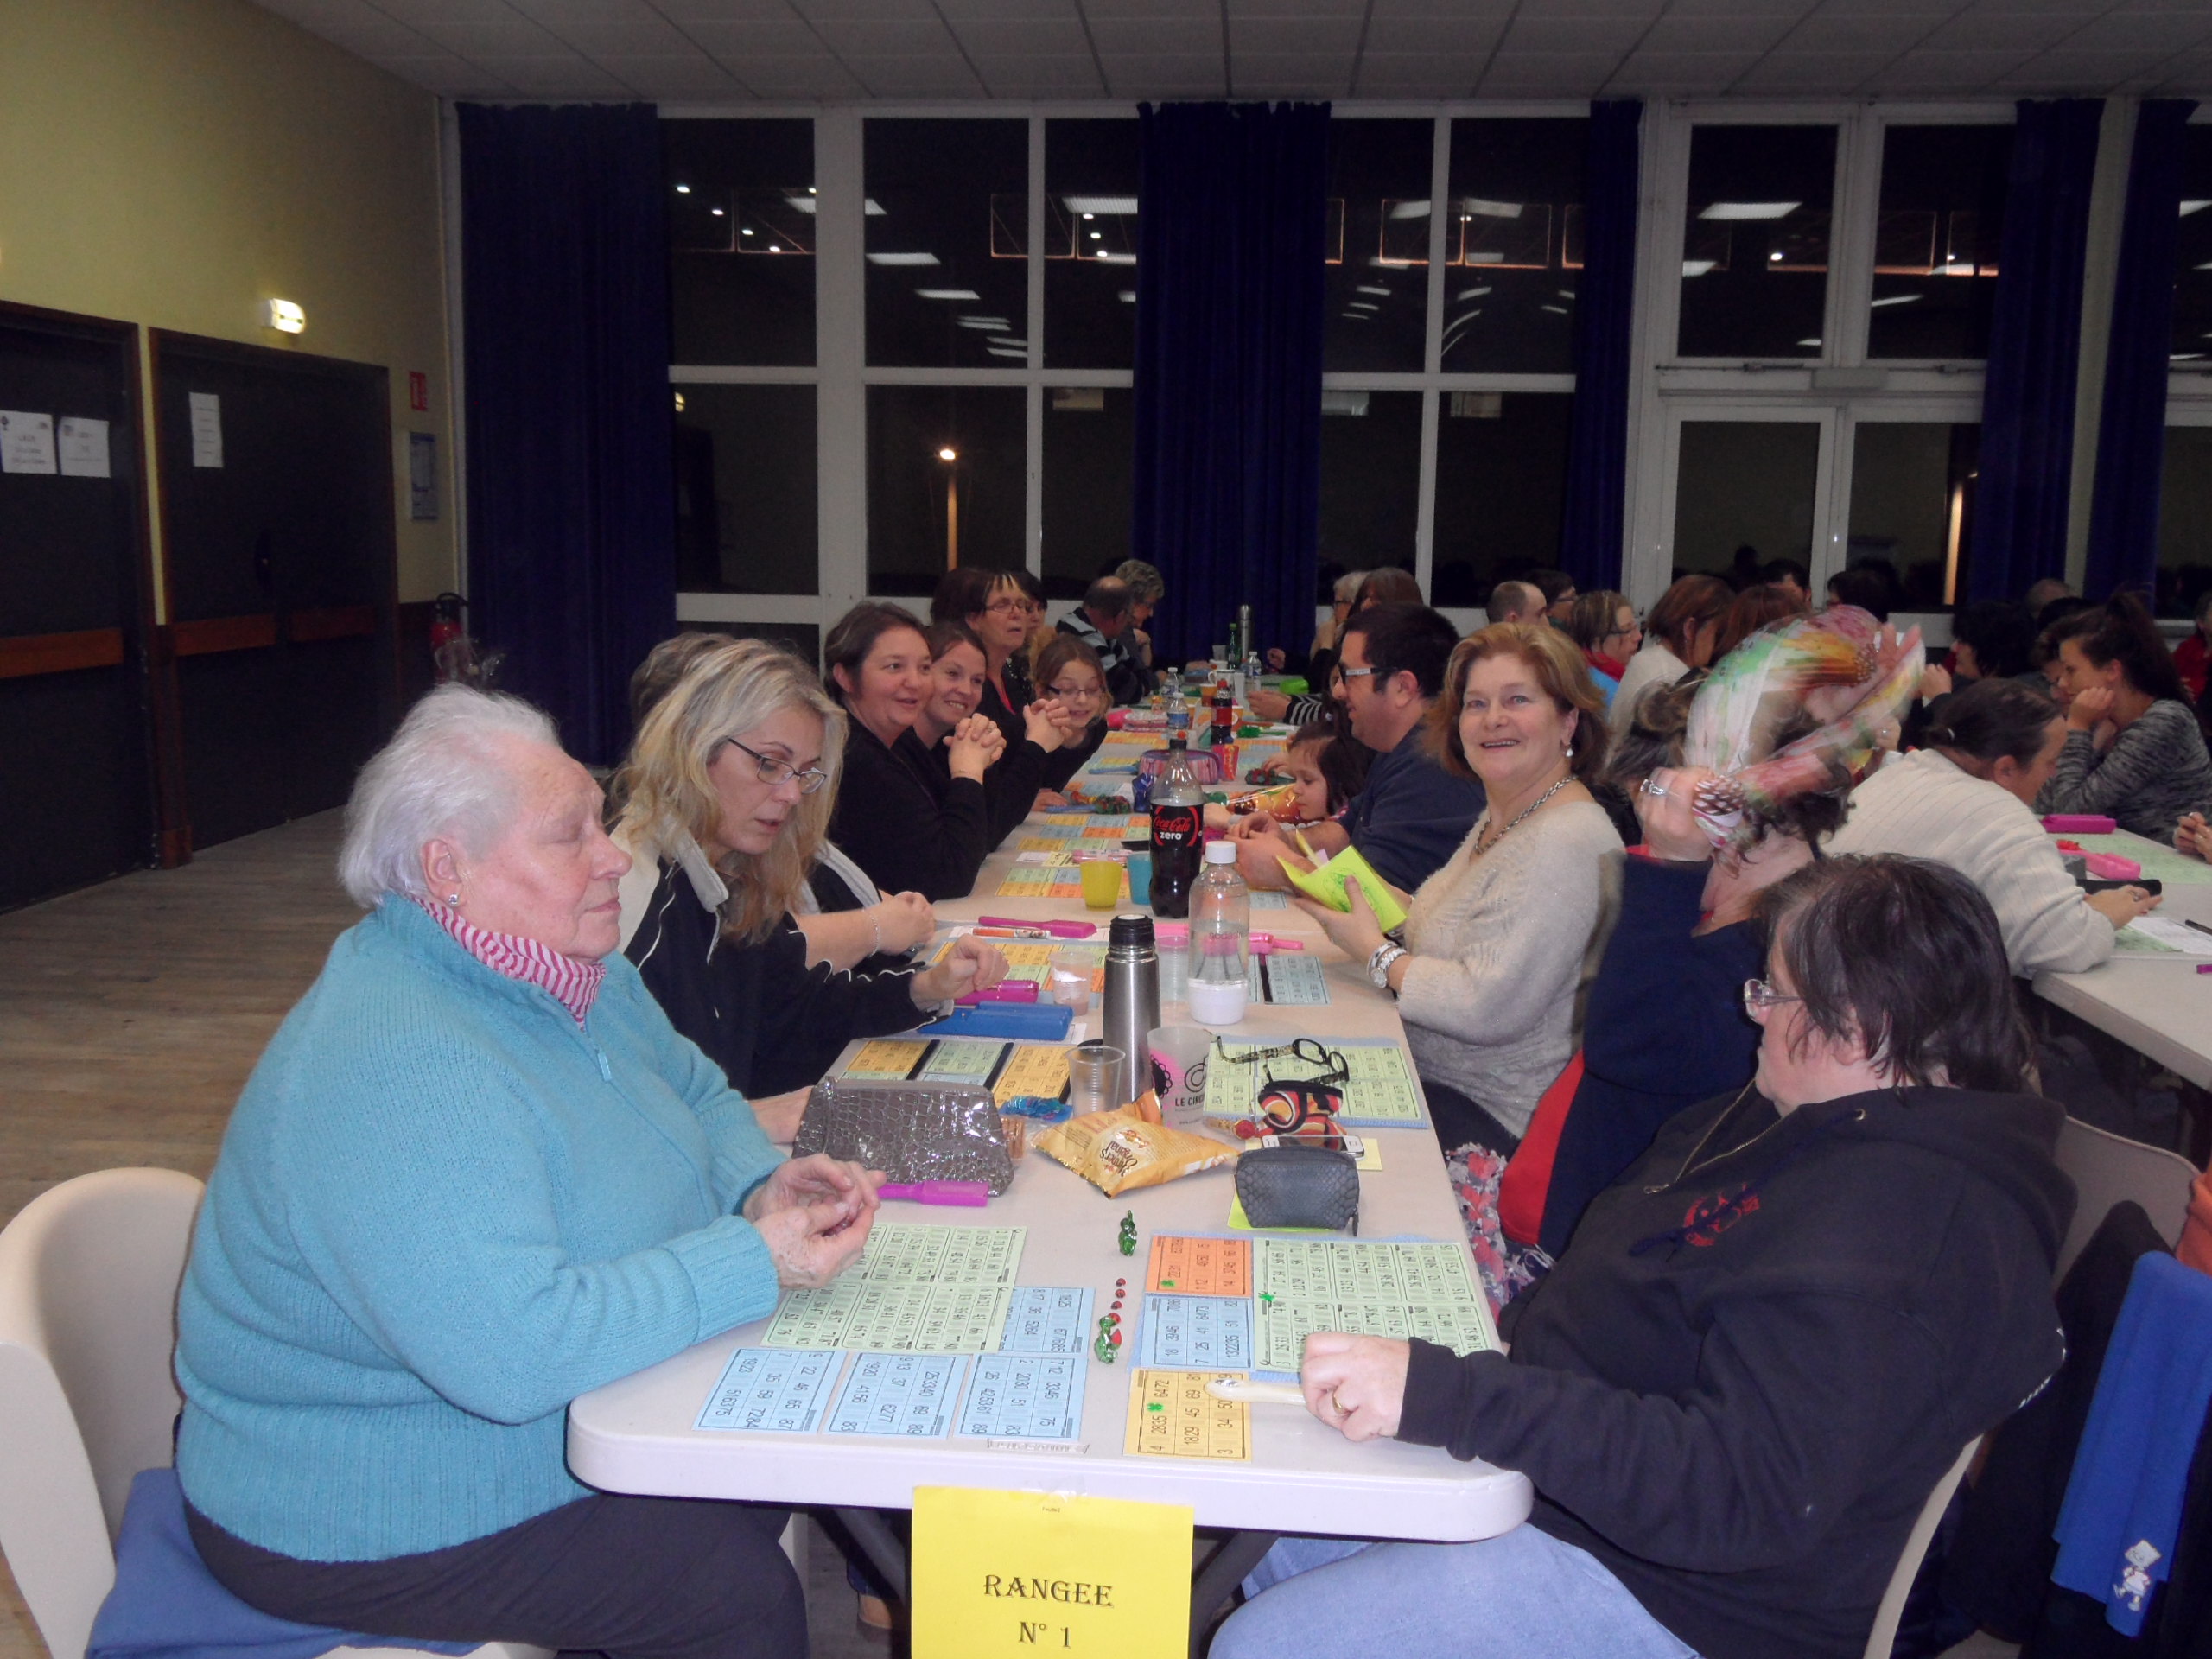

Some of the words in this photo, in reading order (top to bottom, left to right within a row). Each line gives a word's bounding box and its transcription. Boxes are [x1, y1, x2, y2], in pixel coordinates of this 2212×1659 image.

[1160, 832, 1182, 841] zero
[1175, 1097, 1186, 1107] LE
[738, 1364, 753, 1373] 23
[801, 1366, 817, 1375] 22
[862, 1368, 876, 1376] 20
[766, 1373, 782, 1382] 35
[985, 1371, 1000, 1380] 26
[1014, 1381, 1029, 1389] 30
[1155, 1380, 1169, 1389] 72
[757, 1389, 773, 1399] 59
[919, 1388, 934, 1396] 40
[1154, 1389, 1169, 1397] 64
[1185, 1390, 1200, 1399] 69
[720, 1397, 736, 1406] 63
[852, 1394, 868, 1403] 56
[978, 1396, 993, 1405] 53
[785, 1400, 802, 1409] 65
[881, 1404, 897, 1414] 62
[715, 1406, 734, 1415] 75
[748, 1408, 766, 1417] 72
[1185, 1408, 1199, 1417] 45
[746, 1418, 760, 1428] 84
[878, 1414, 893, 1423] 77
[1152, 1415, 1166, 1425] 35
[1217, 1419, 1233, 1427] 34
[779, 1419, 792, 1428] 87
[841, 1421, 857, 1432] 83
[907, 1424, 923, 1434] 89
[1005, 1425, 1020, 1434] 83
[1151, 1426, 1166, 1434] 28
[1185, 1427, 1199, 1436] 29
[983, 1573, 1115, 1608] RANGEE
[1018, 1620, 1047, 1645] N°
[1060, 1626, 1071, 1649] 1
